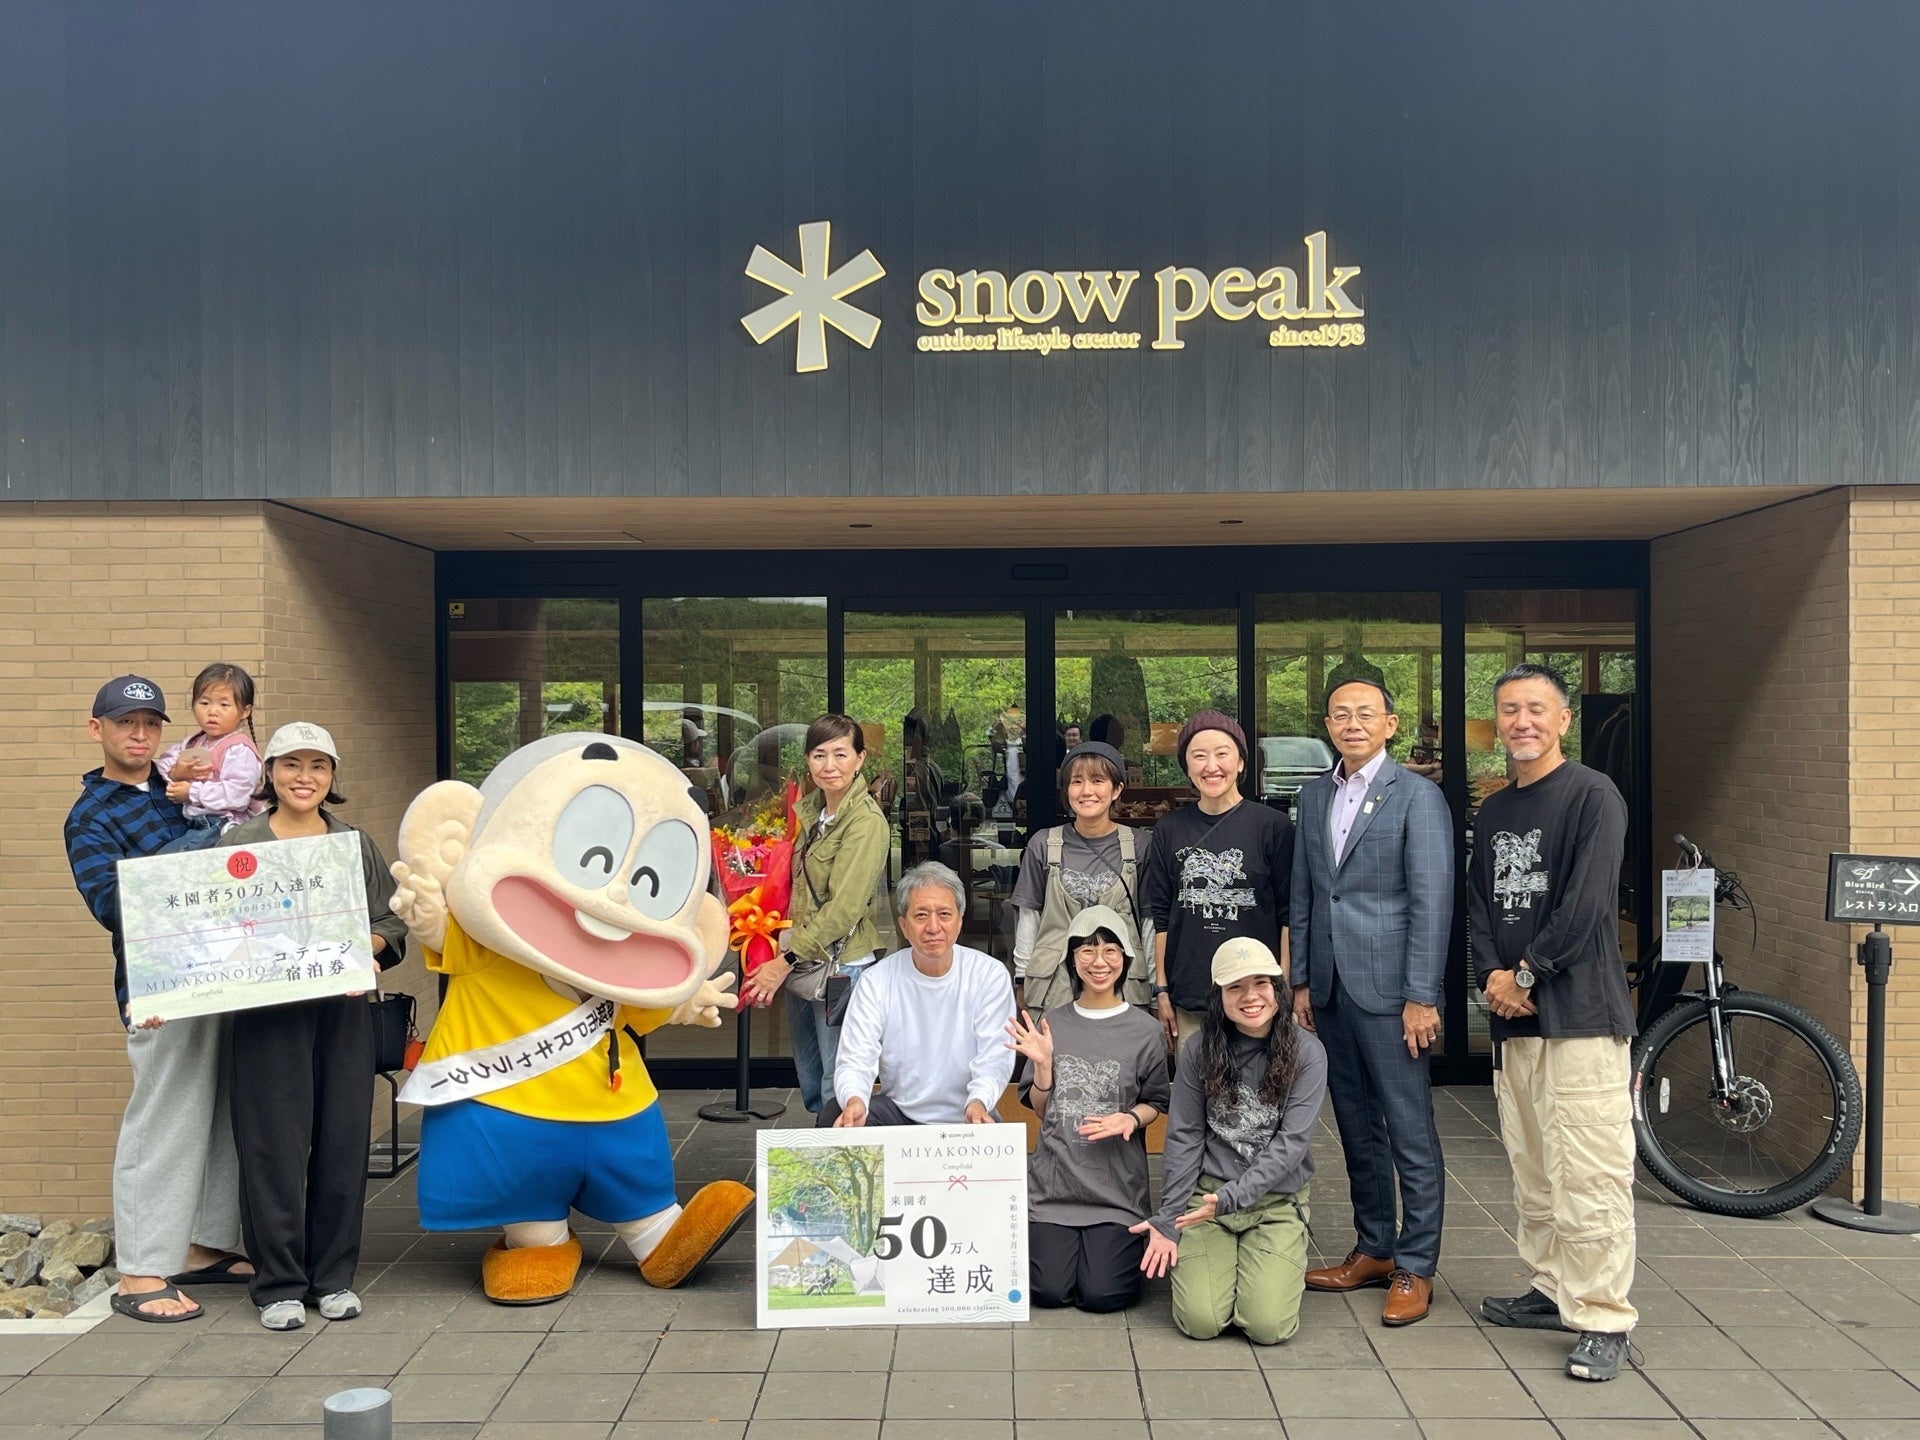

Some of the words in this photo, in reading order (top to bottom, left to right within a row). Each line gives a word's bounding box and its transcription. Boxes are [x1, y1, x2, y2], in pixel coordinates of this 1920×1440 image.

[916, 269, 1140, 326] snow
[1152, 231, 1364, 350] peak
[917, 327, 996, 351] outdoor
[997, 326, 1071, 355] lifestyle
[1072, 331, 1141, 349] creator
[1269, 324, 1366, 347] since1958
[235, 857, 251, 873] 祝
[165, 875, 324, 909] 来園者50万人達成
[1845, 900, 1919, 913] レストラン入口
[275, 940, 353, 962] コテージ
[146, 966, 266, 993] MIYAKONOJO
[286, 959, 346, 982] 宿泊券
[1827, 1081, 1847, 1154] KENDA
[900, 1145, 1014, 1159] MIYAKONOJO
[942, 1163, 973, 1171] Campfield
[890, 1195, 928, 1207] 来園者
[927, 1264, 994, 1295] 達成
